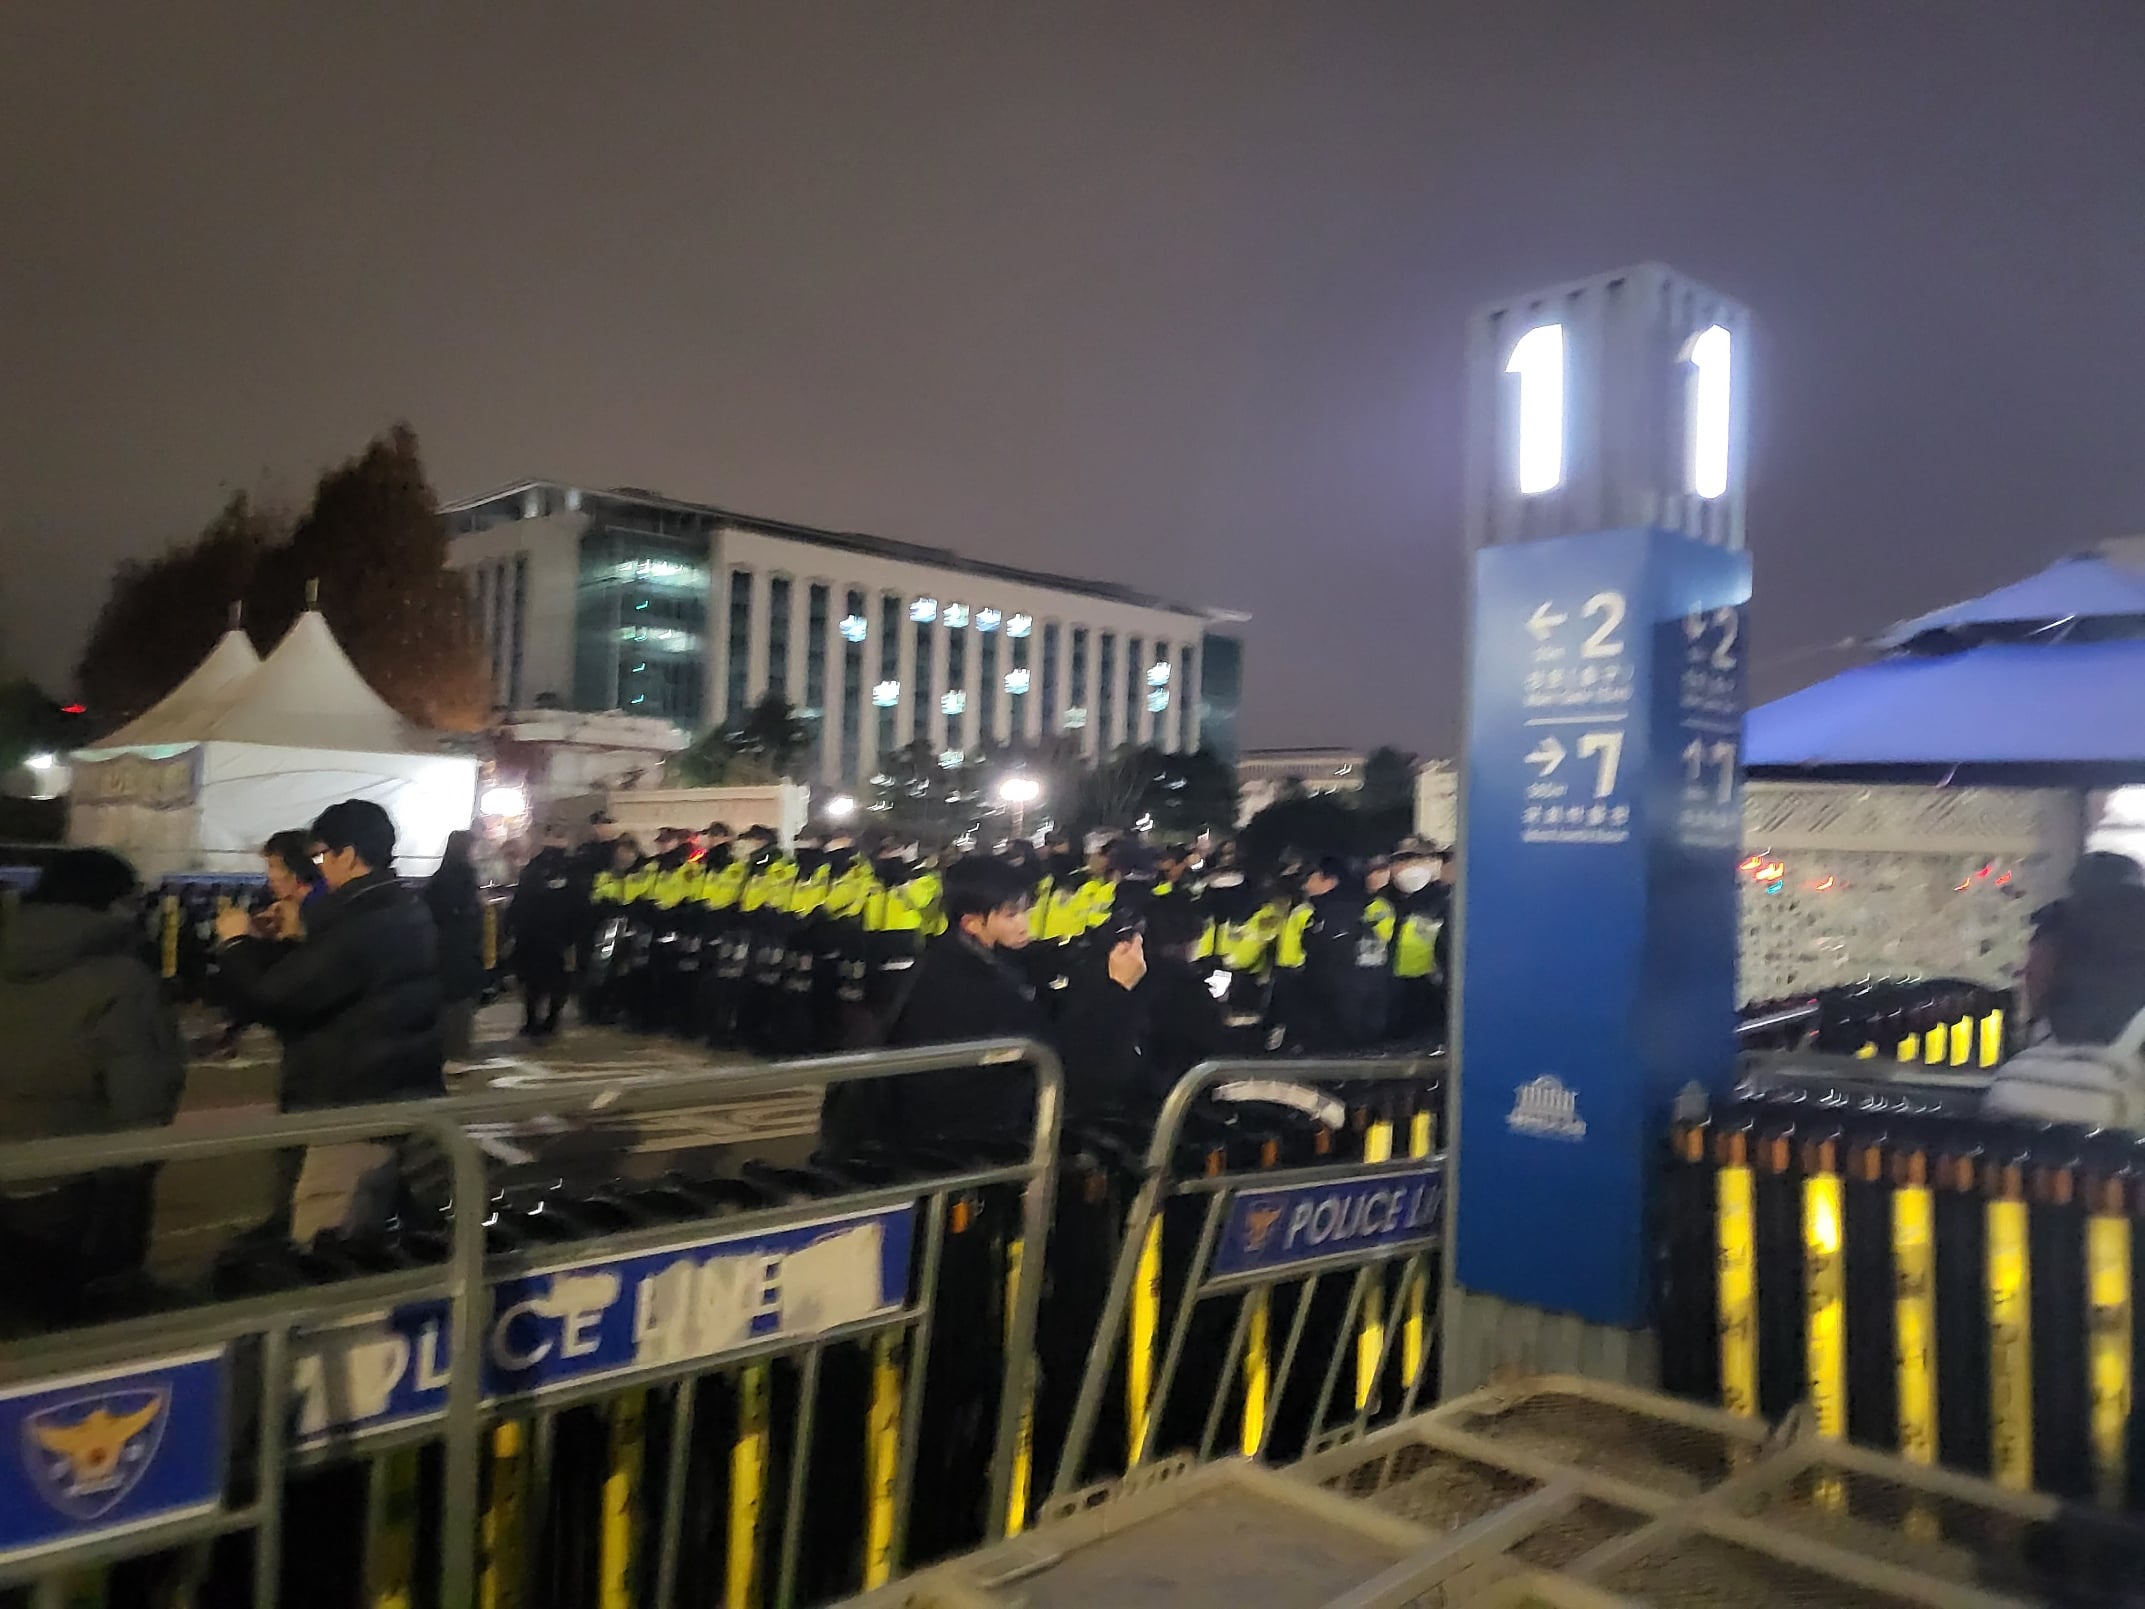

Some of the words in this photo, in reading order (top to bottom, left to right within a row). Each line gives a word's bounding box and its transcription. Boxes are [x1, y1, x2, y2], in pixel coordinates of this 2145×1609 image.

[1505, 323, 1564, 494] 1
[1678, 324, 1731, 499] 1
[1579, 591, 1626, 659] 2
[1711, 606, 1738, 671] 2
[1576, 730, 1624, 798] 7
[1284, 1187, 1408, 1251] POLICE
